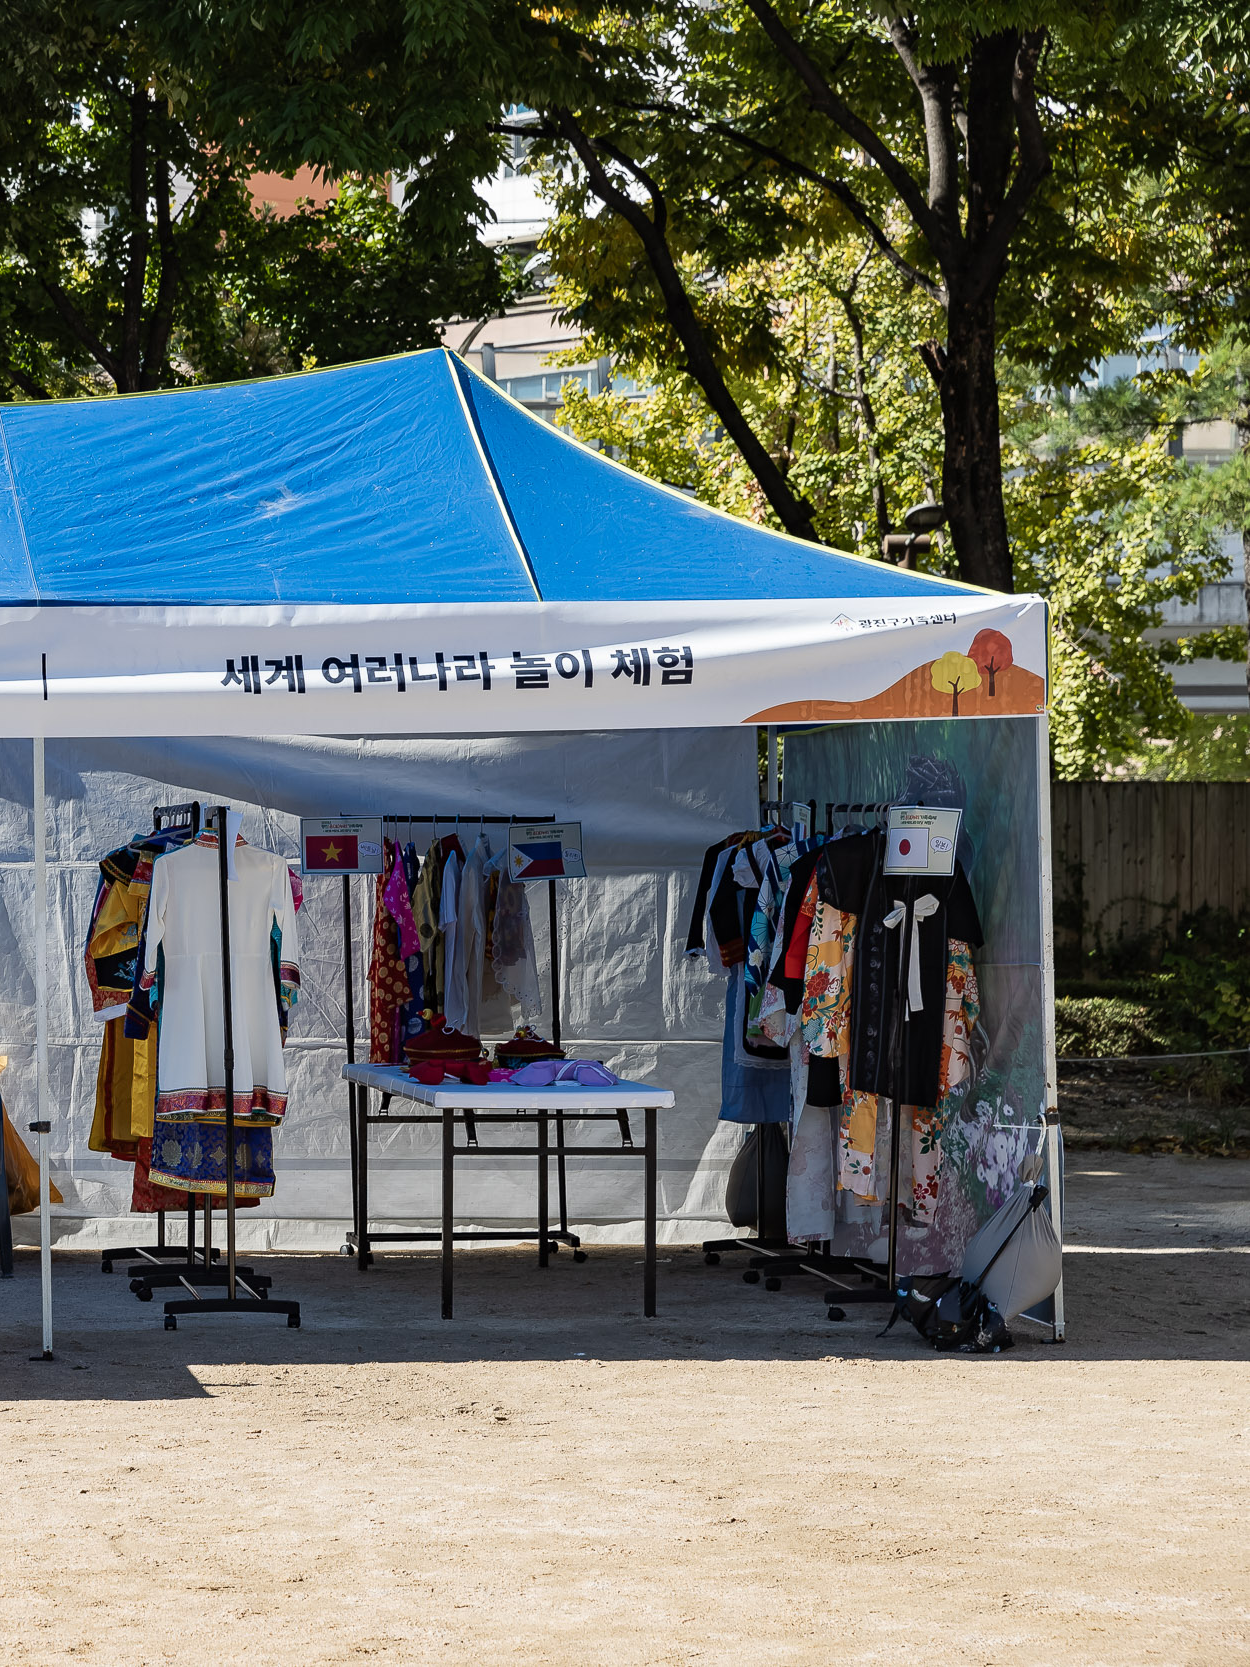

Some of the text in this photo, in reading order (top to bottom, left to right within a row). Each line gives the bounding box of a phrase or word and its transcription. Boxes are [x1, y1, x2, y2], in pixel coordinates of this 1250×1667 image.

[220, 645, 695, 695] 세계 여러나라 놀이 체험
